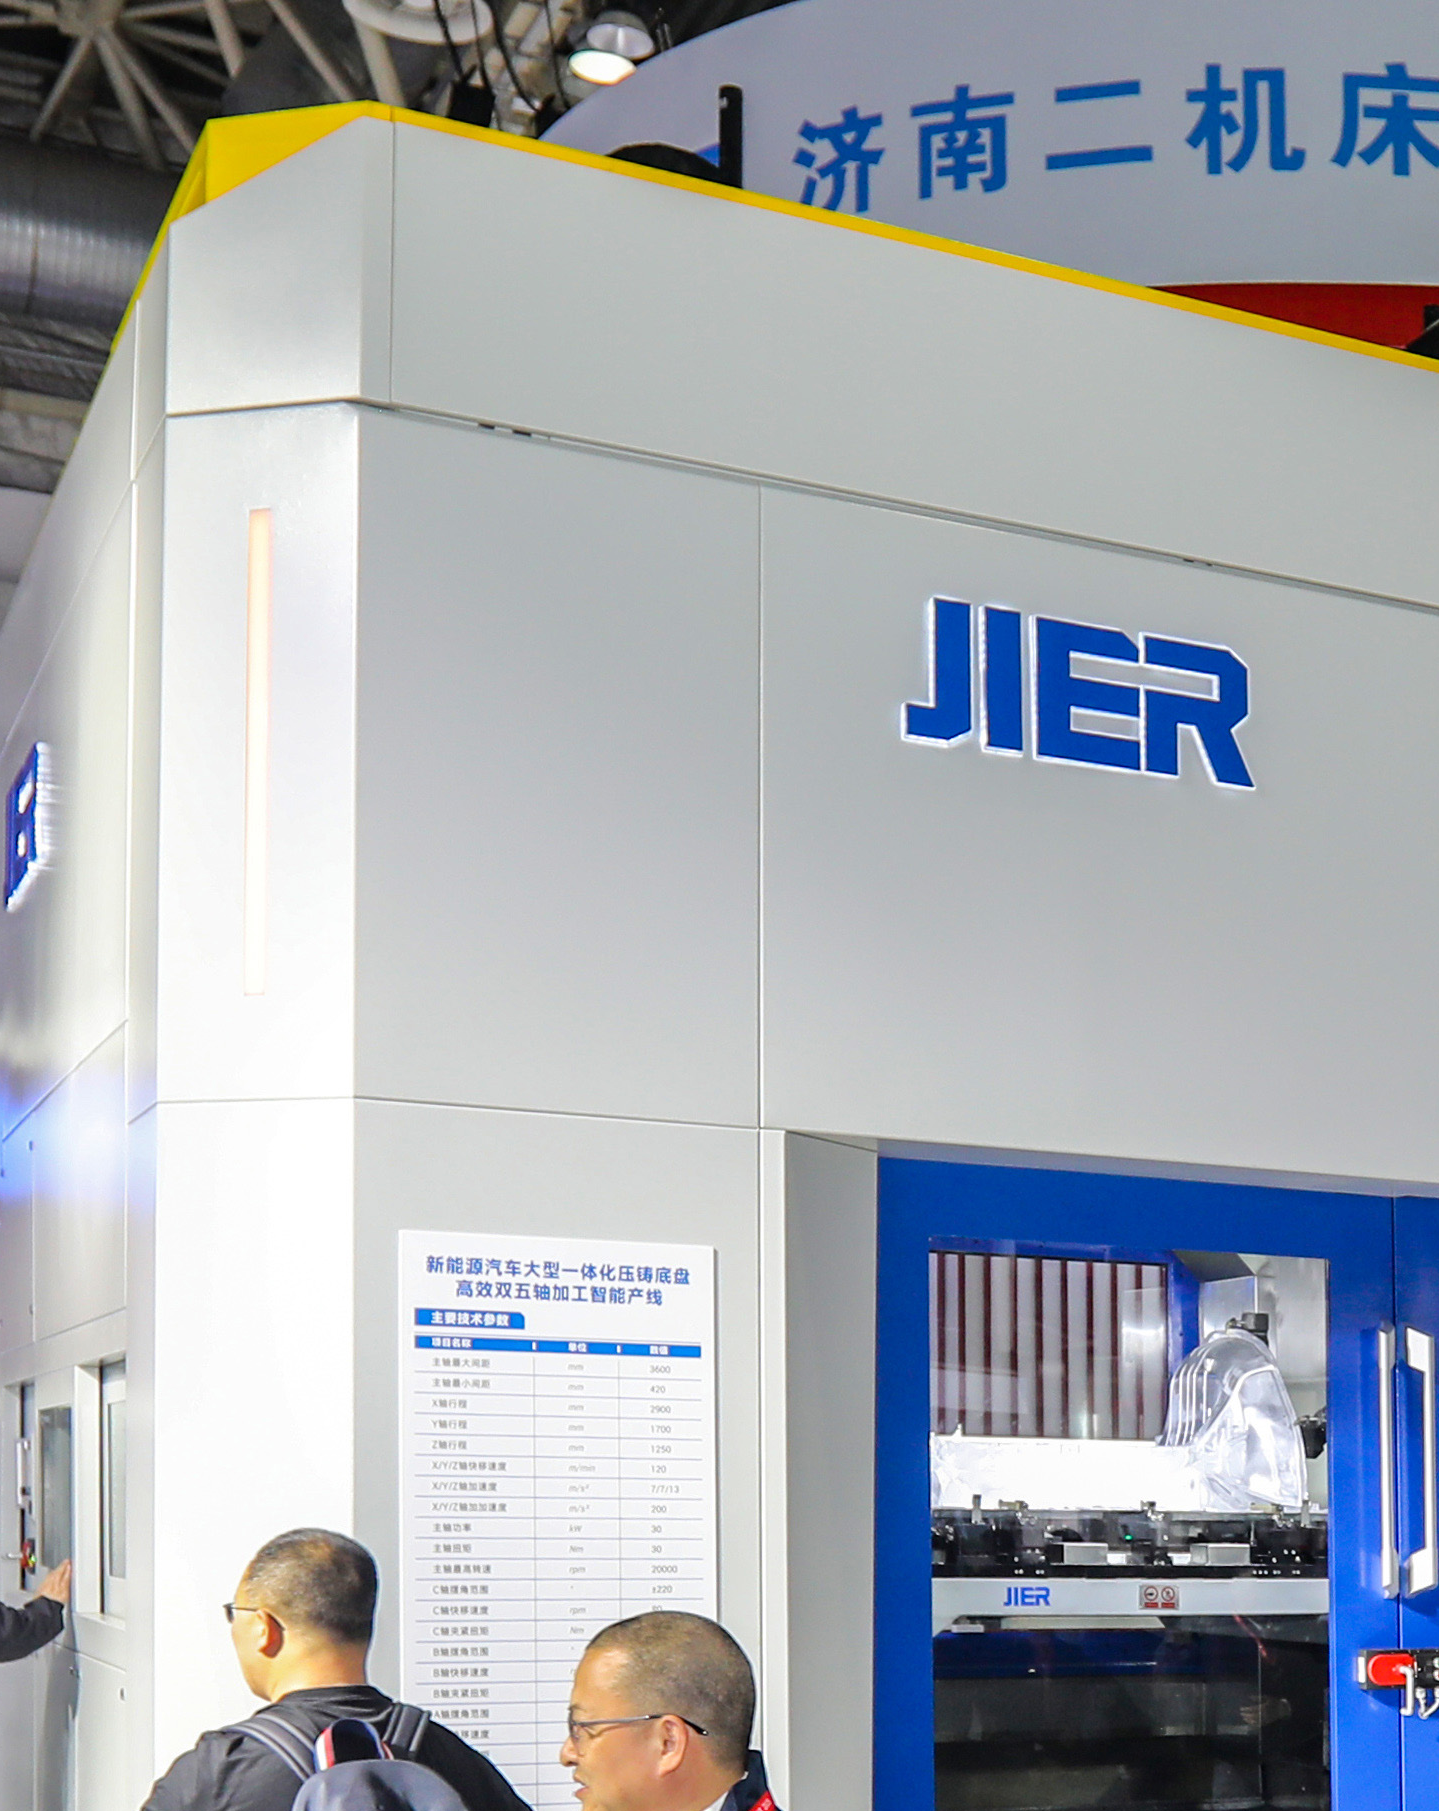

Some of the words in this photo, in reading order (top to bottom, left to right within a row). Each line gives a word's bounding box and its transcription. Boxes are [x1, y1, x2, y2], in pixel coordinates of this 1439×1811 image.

[900, 596, 1256, 790] JIER
[425, 1255, 691, 1285] 新能源汽车大型一体化压铸底盘
[455, 1280, 664, 1306] 高效双五轴加工智能产线
[430, 1311, 511, 1328] 主要技术参数
[650, 1365, 670, 1374] 3600
[650, 1385, 666, 1394] 420
[650, 1406, 670, 1414] 2900
[651, 1425, 671, 1434] 1700
[651, 1445, 671, 1454] 1250
[651, 1465, 666, 1473] 120
[651, 1485, 679, 1494] 7/7/13
[651, 1505, 666, 1513] 200
[651, 1525, 662, 1533] 30
[651, 1545, 662, 1553] 30
[652, 1565, 678, 1573] 20000
[1003, 1586, 1051, 1607] JIER
